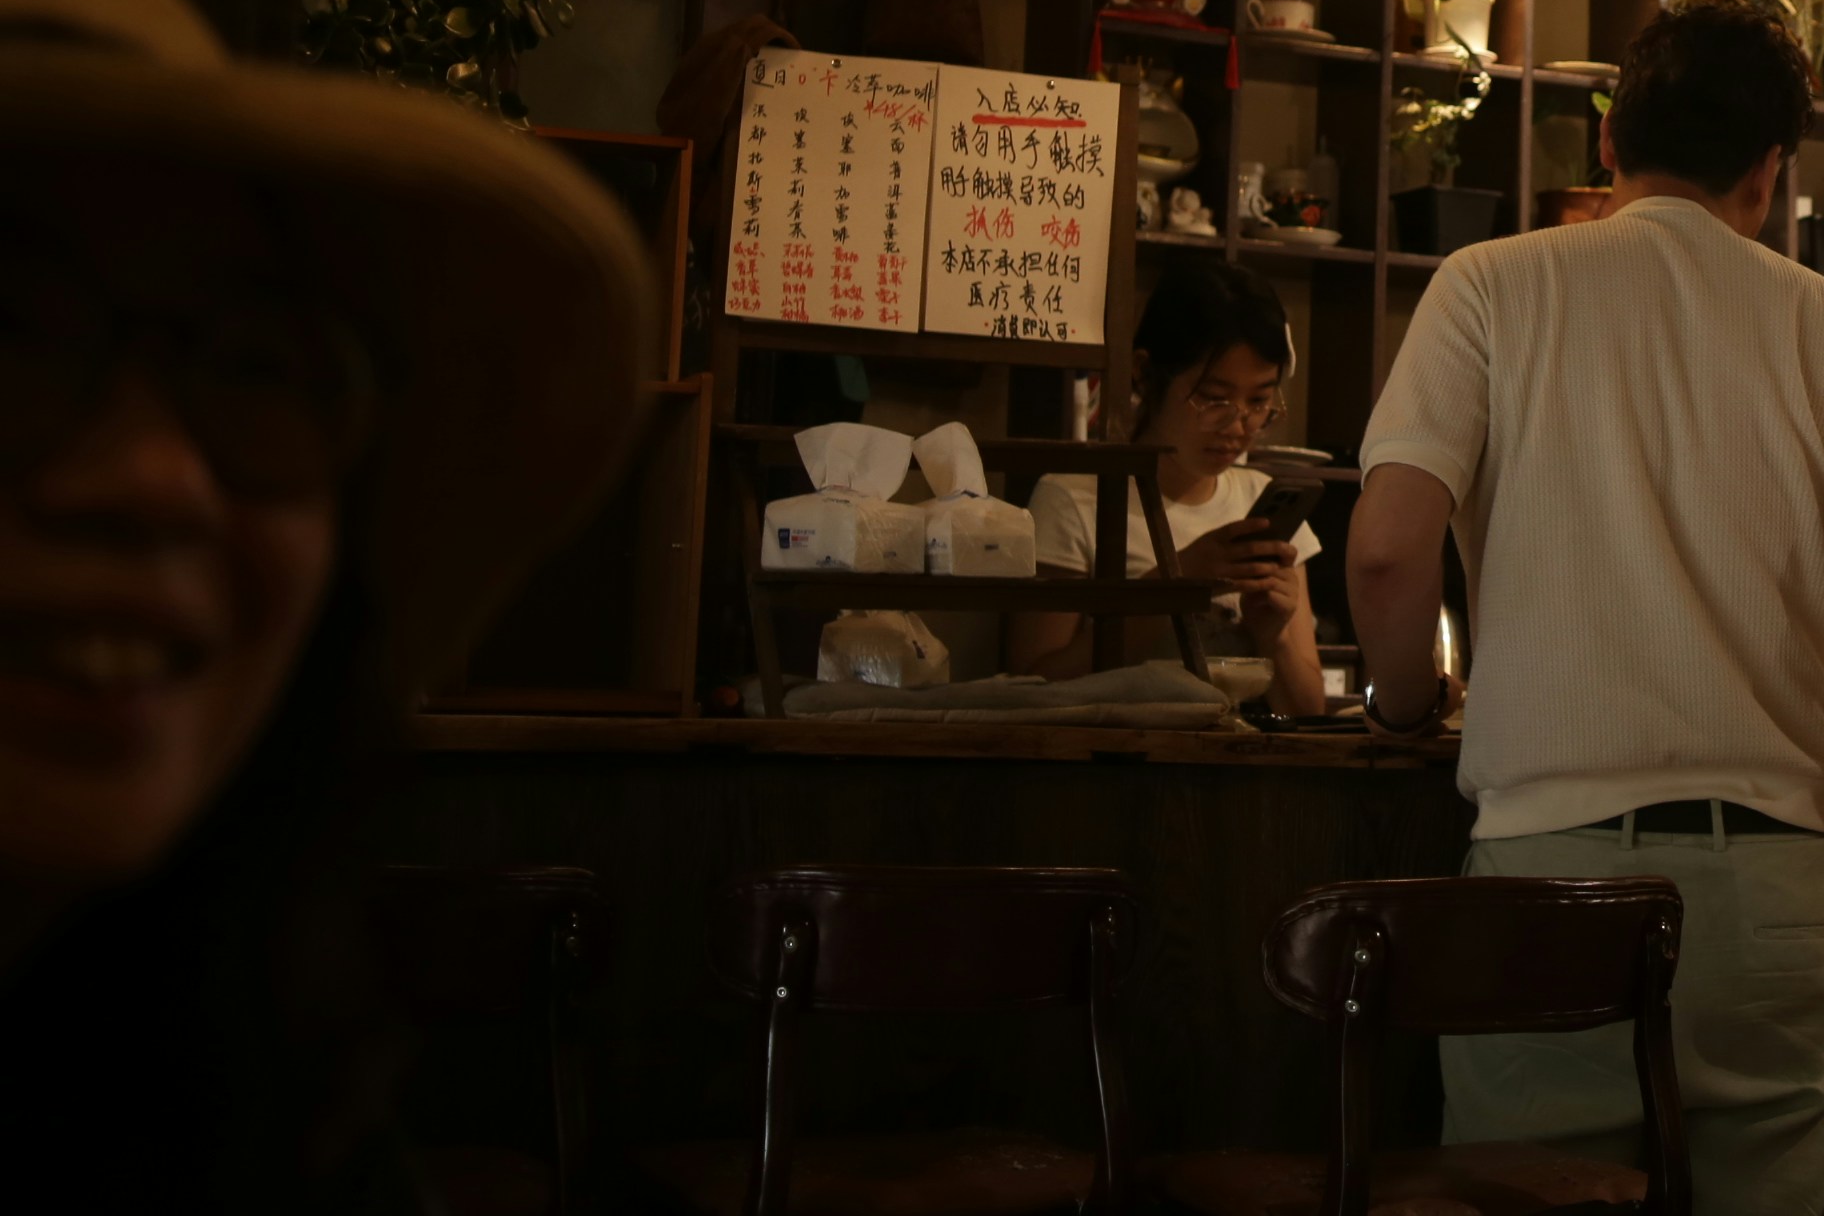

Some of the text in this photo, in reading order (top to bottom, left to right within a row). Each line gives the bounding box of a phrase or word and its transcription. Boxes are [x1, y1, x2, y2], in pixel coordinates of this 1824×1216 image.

[951, 121, 1104, 177] 请勿用手触摸
[940, 165, 1085, 210] 用手触摸导致的
[964, 204, 1081, 251] 抓伤 咬伤
[941, 239, 1081, 283] 本店不承担任何
[967, 279, 1064, 317] 医疗责任
